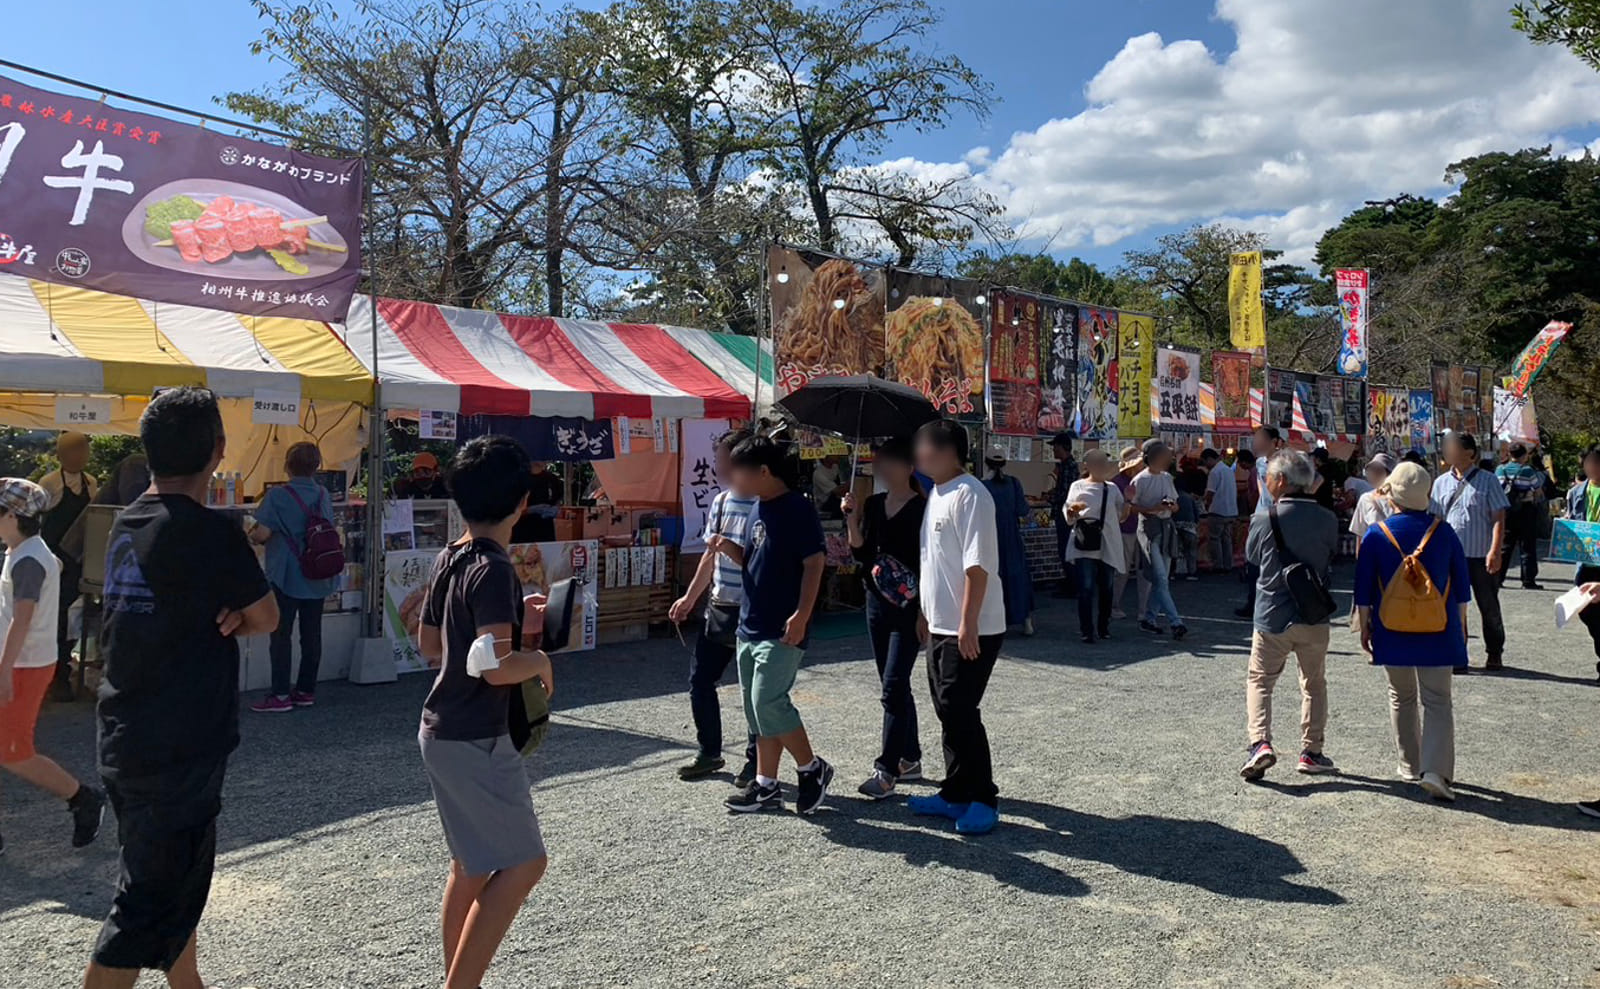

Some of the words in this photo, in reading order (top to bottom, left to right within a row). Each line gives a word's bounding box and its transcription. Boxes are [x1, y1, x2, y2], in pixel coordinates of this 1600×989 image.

[241, 153, 351, 185] かながわブランド
[201, 281, 330, 308] 相州牛推進協議会
[69, 411, 97, 421] 和牛屋
[254, 400, 296, 412] 受け渡し口
[1160, 391, 1199, 421] 五平餅
[556, 425, 609, 456] ぎょうざ
